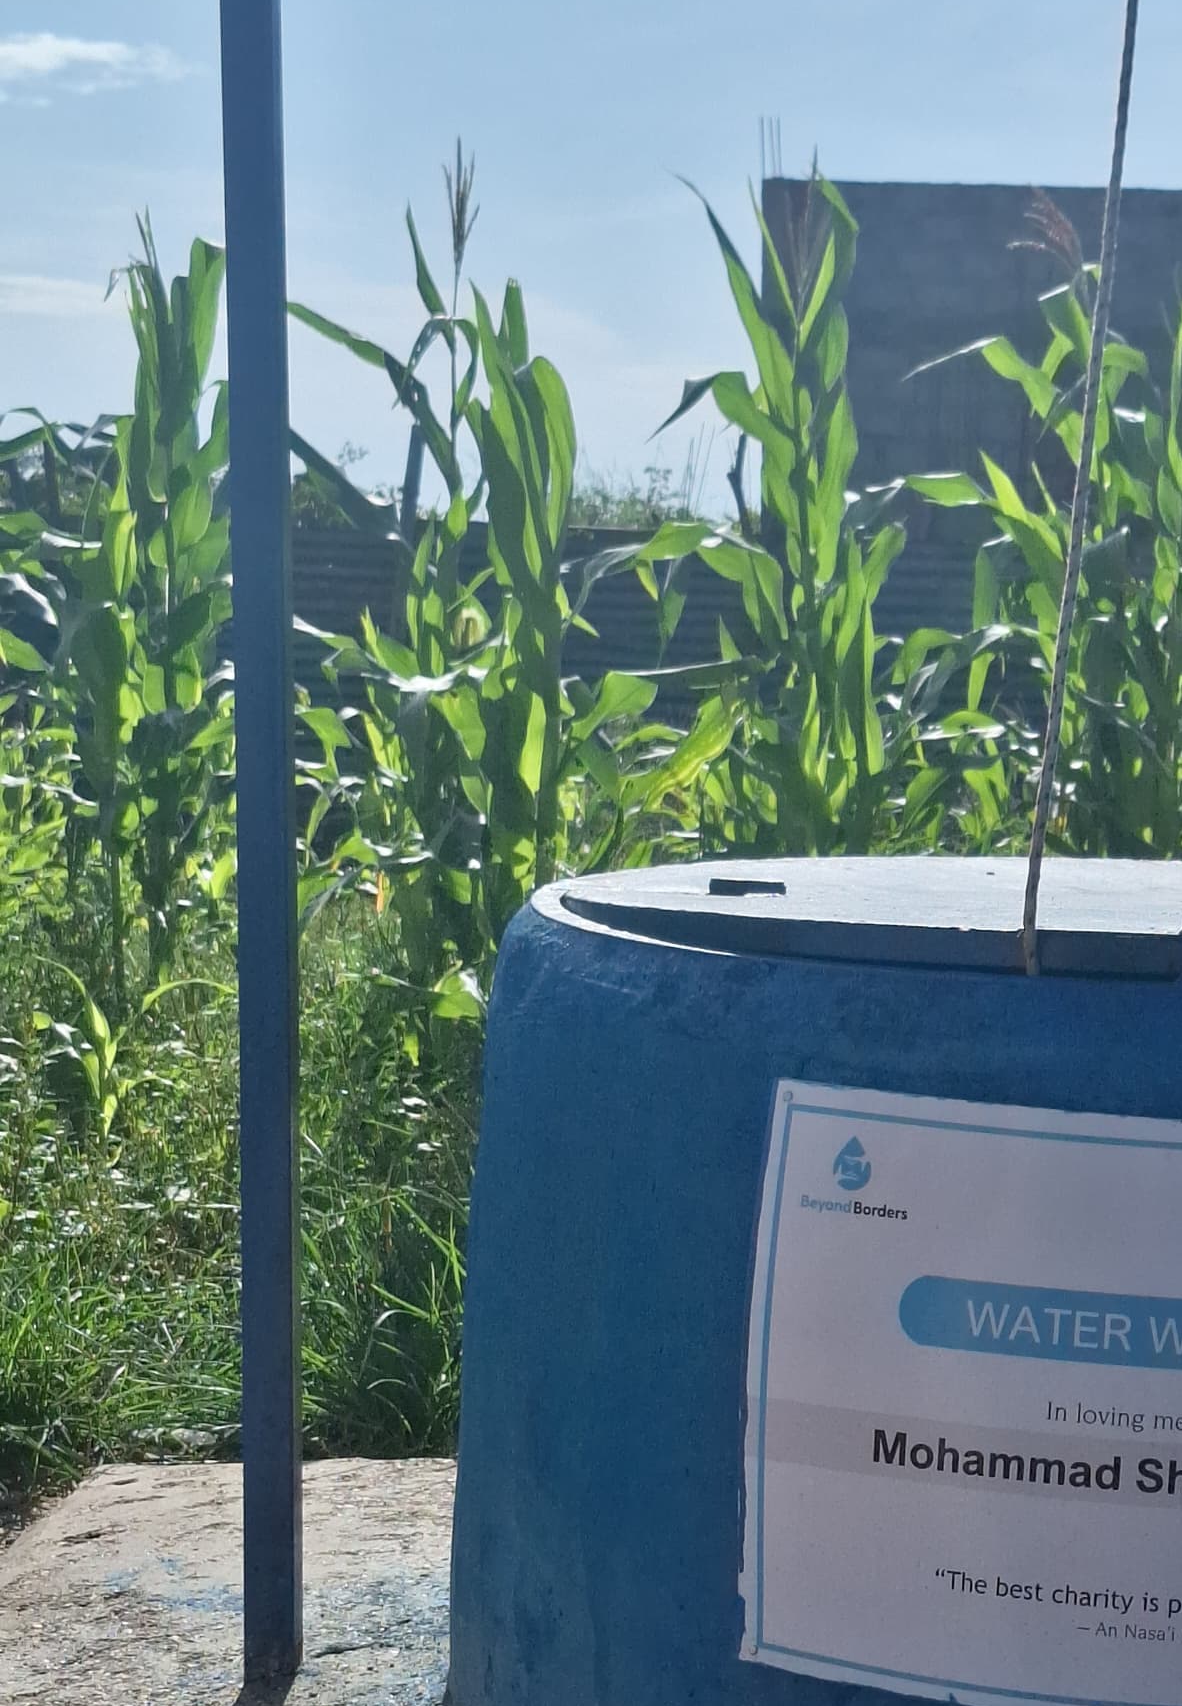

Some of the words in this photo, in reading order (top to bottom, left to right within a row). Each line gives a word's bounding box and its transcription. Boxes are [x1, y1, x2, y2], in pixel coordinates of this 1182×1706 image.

[967, 1299, 1131, 1353] WATER
[1046, 1401, 1067, 1422] In
[1076, 1402, 1145, 1433] loving
[872, 1429, 1121, 1491] Mohammad
[995, 1576, 1044, 1602] best
[1051, 1584, 1134, 1615] charity
[1142, 1592, 1160, 1613] is
[1095, 1622, 1118, 1638] An
